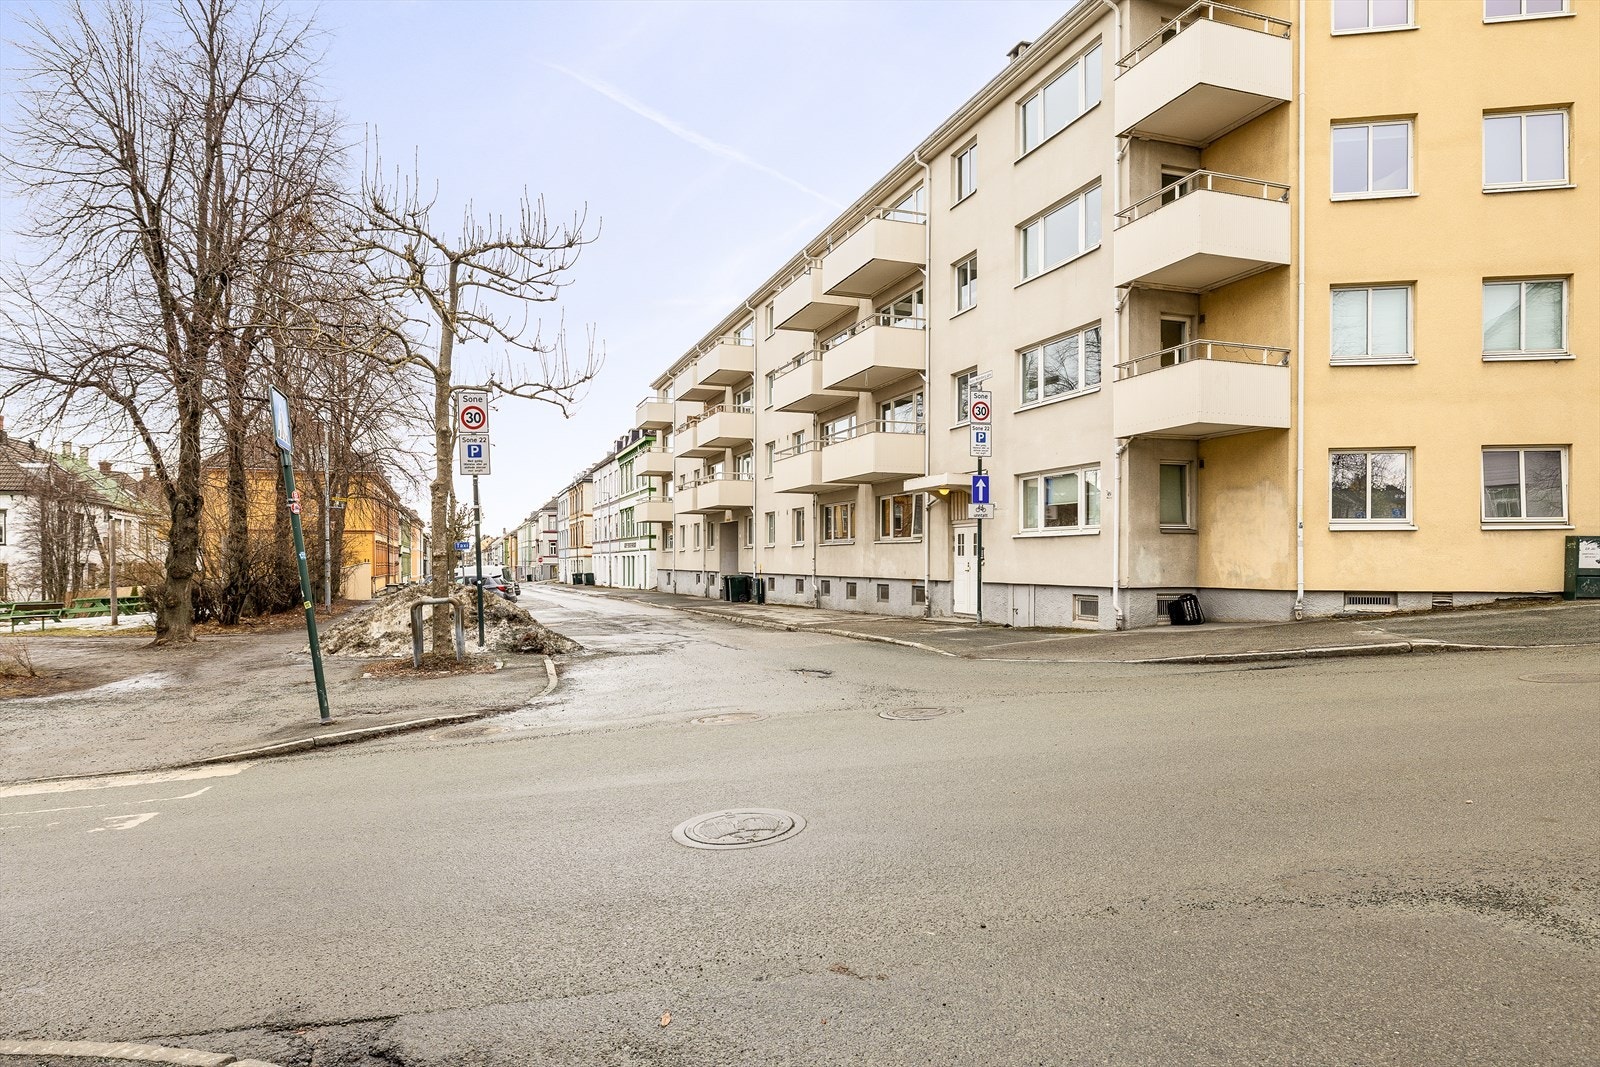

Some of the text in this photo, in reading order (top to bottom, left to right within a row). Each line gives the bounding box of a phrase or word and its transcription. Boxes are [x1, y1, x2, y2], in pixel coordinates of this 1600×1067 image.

[975, 406, 986, 416] 30
[466, 412, 481, 423] 30
[471, 446, 479, 456] P
